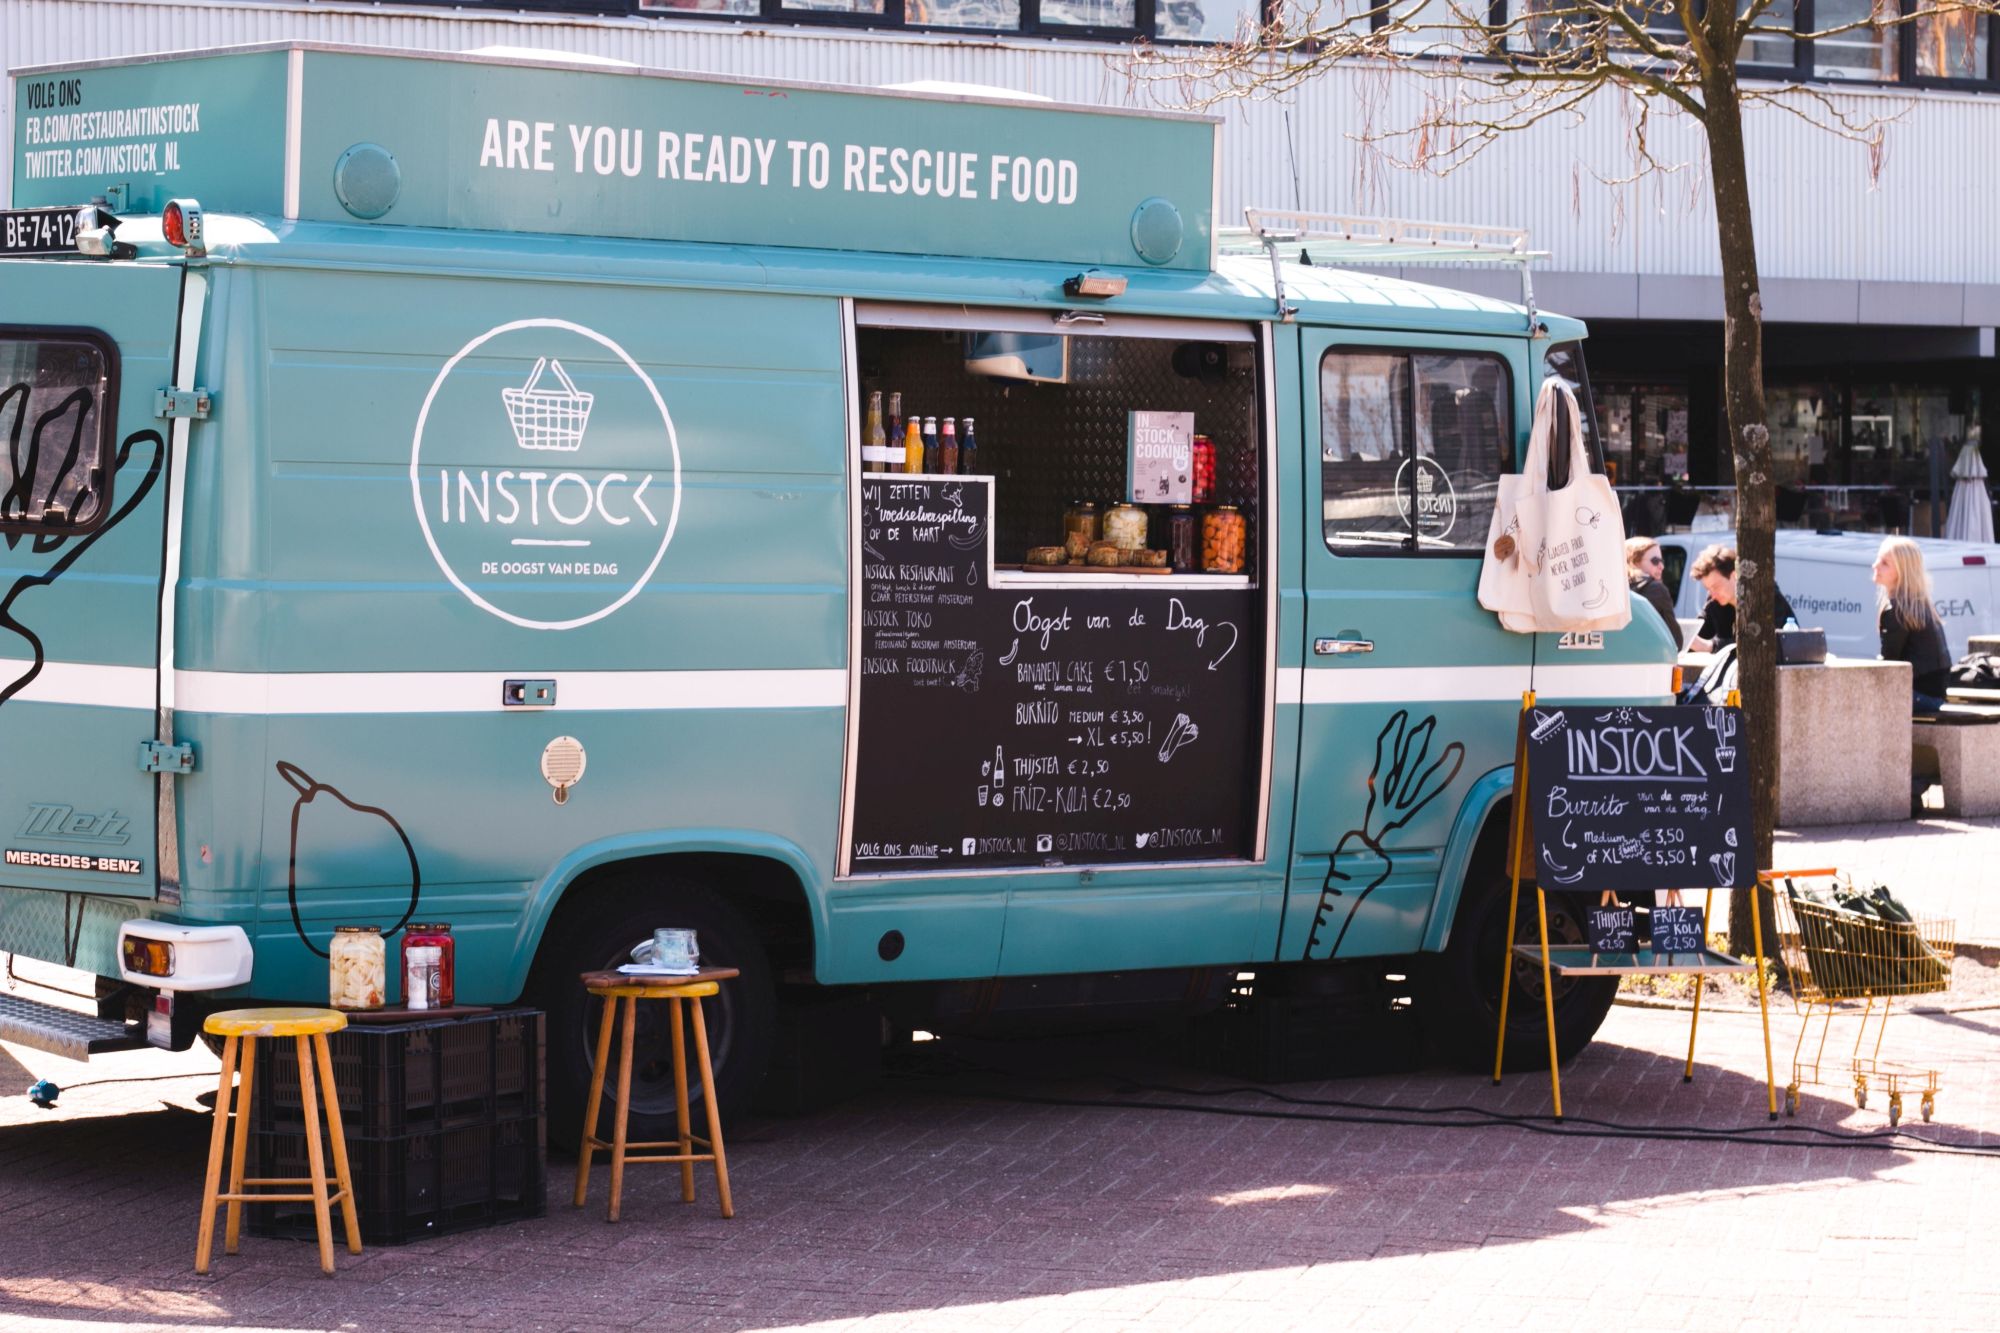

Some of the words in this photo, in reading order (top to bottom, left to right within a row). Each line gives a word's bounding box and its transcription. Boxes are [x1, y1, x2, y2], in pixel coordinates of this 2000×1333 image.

[27, 80, 55, 110] VOLG
[59, 78, 82, 107] ONS
[26, 102, 200, 145] FB.COM/RESTAURANTINSTOCK
[25, 141, 180, 179] TWITTER.COM/INSTOCK_NL
[480, 118, 554, 171] ARE
[568, 124, 643, 177] YOU
[658, 131, 776, 185] READY
[787, 140, 830, 190] TO
[843, 144, 978, 199] RESCUE
[991, 155, 1078, 205] FOOD
[6, 214, 76, 248] BE-74-12
[1136, 443, 1189, 459] COOKING
[441, 469, 658, 526] INSTOCK
[889, 484, 930, 500] ZETTEN
[869, 528, 880, 541] OP
[888, 527, 900, 541] DE
[912, 526, 940, 543] KAART
[481, 562, 498, 575] DE
[501, 562, 546, 575] OOGST
[548, 562, 572, 575] VAN
[574, 562, 591, 575] DE
[593, 563, 618, 576] DAG
[864, 564, 896, 581] NSTOCK
[900, 564, 955, 583] RESTAURANT
[1935, 599, 1975, 617] GEA
[863, 609, 899, 628] INSTOCK
[905, 610, 932, 629] TOKO
[1013, 596, 1072, 651] Oogst
[1087, 614, 1111, 629] van
[1128, 607, 1146, 626] de
[1165, 598, 1209, 649] Dag
[862, 658, 899, 674] INSTOCK
[906, 657, 956, 674] FOODTRUCK
[1017, 661, 1060, 684] BANANEN
[1066, 660, 1093, 684] CAKE
[1069, 711, 1103, 723] MEDIUM
[1086, 727, 1104, 747] XL
[1566, 726, 1708, 777] INSTOCK
[1547, 786, 1630, 818] Burrito
[855, 842, 880, 856] VOLG
[883, 843, 902, 856] ONS
[1586, 849, 1598, 864] of
[1602, 847, 1622, 864] XL
[6, 850, 140, 873] MERCEDES-BENZ
[1673, 923, 1702, 935] KOLA
